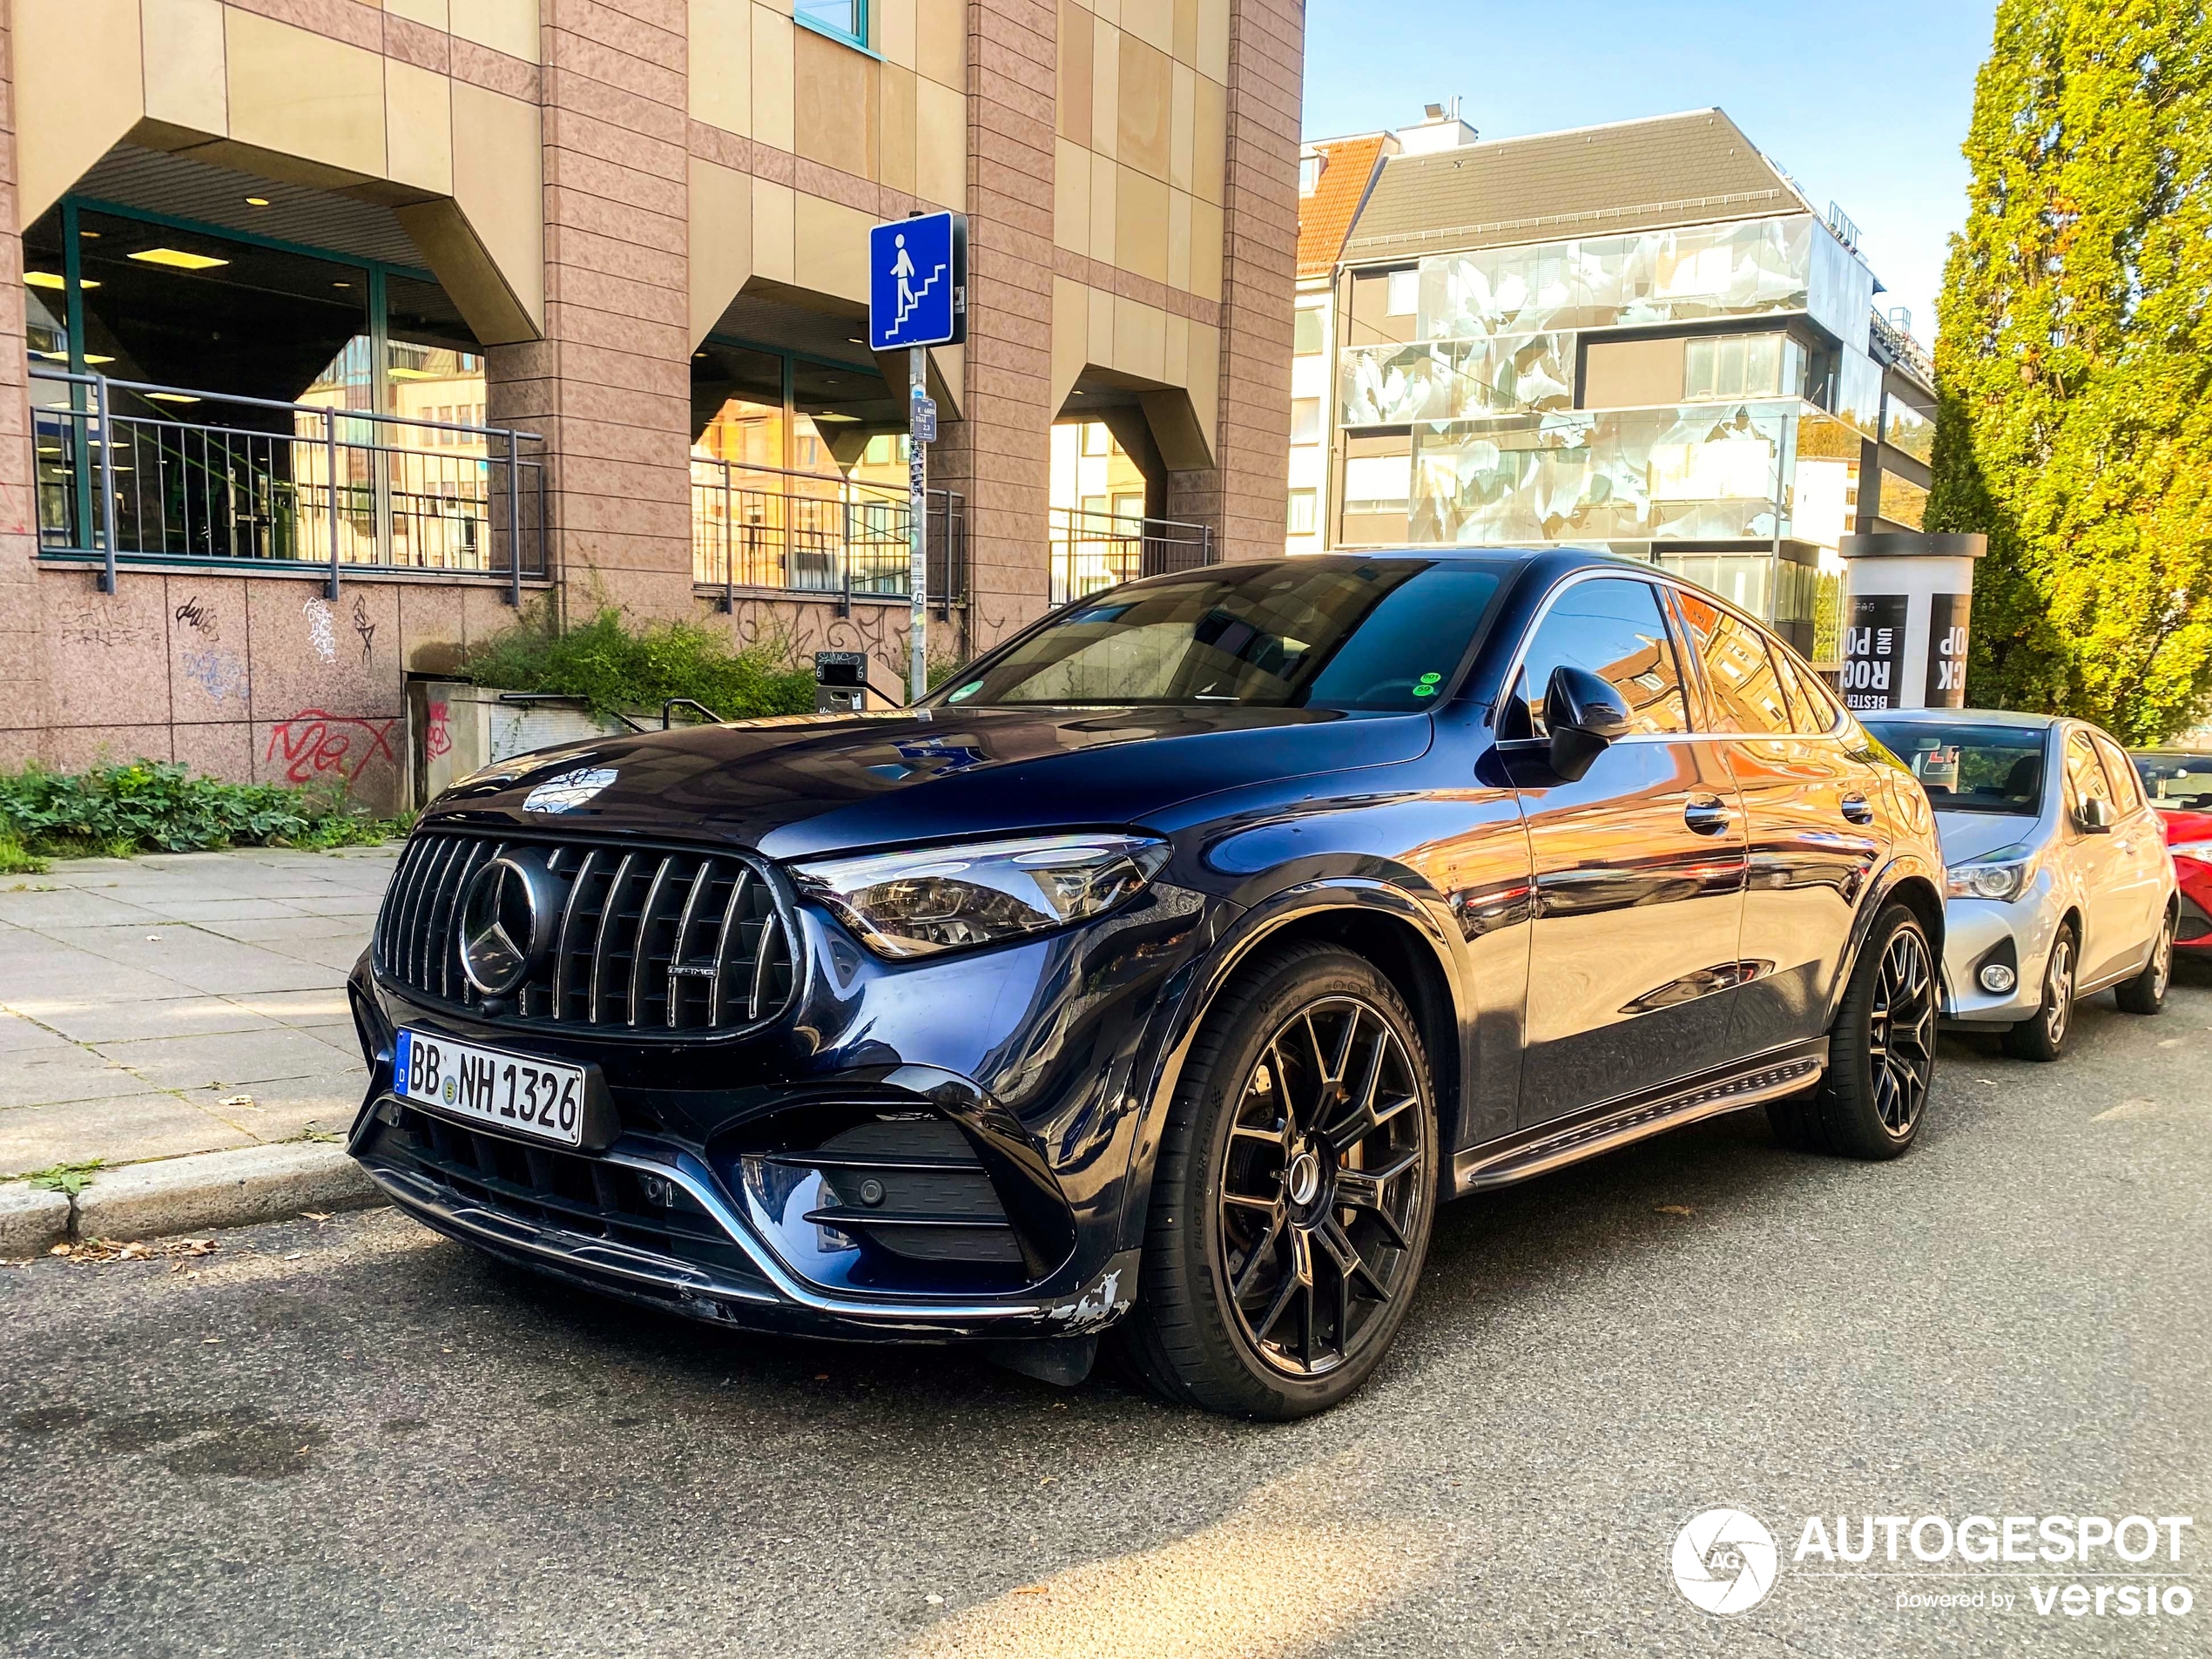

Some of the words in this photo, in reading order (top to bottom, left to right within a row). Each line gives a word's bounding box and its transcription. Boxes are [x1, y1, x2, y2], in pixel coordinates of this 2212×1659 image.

[1877, 628, 1892, 655] UND
[816, 665, 822, 678] 6
[857, 665, 864, 679] 6
[1843, 660, 1891, 690] ROC
[1847, 694, 1888, 709] BESTER
[398, 1068, 406, 1083] D
[410, 1040, 440, 1095] BB
[458, 1053, 496, 1113] NH
[500, 1063, 577, 1131] 1326
